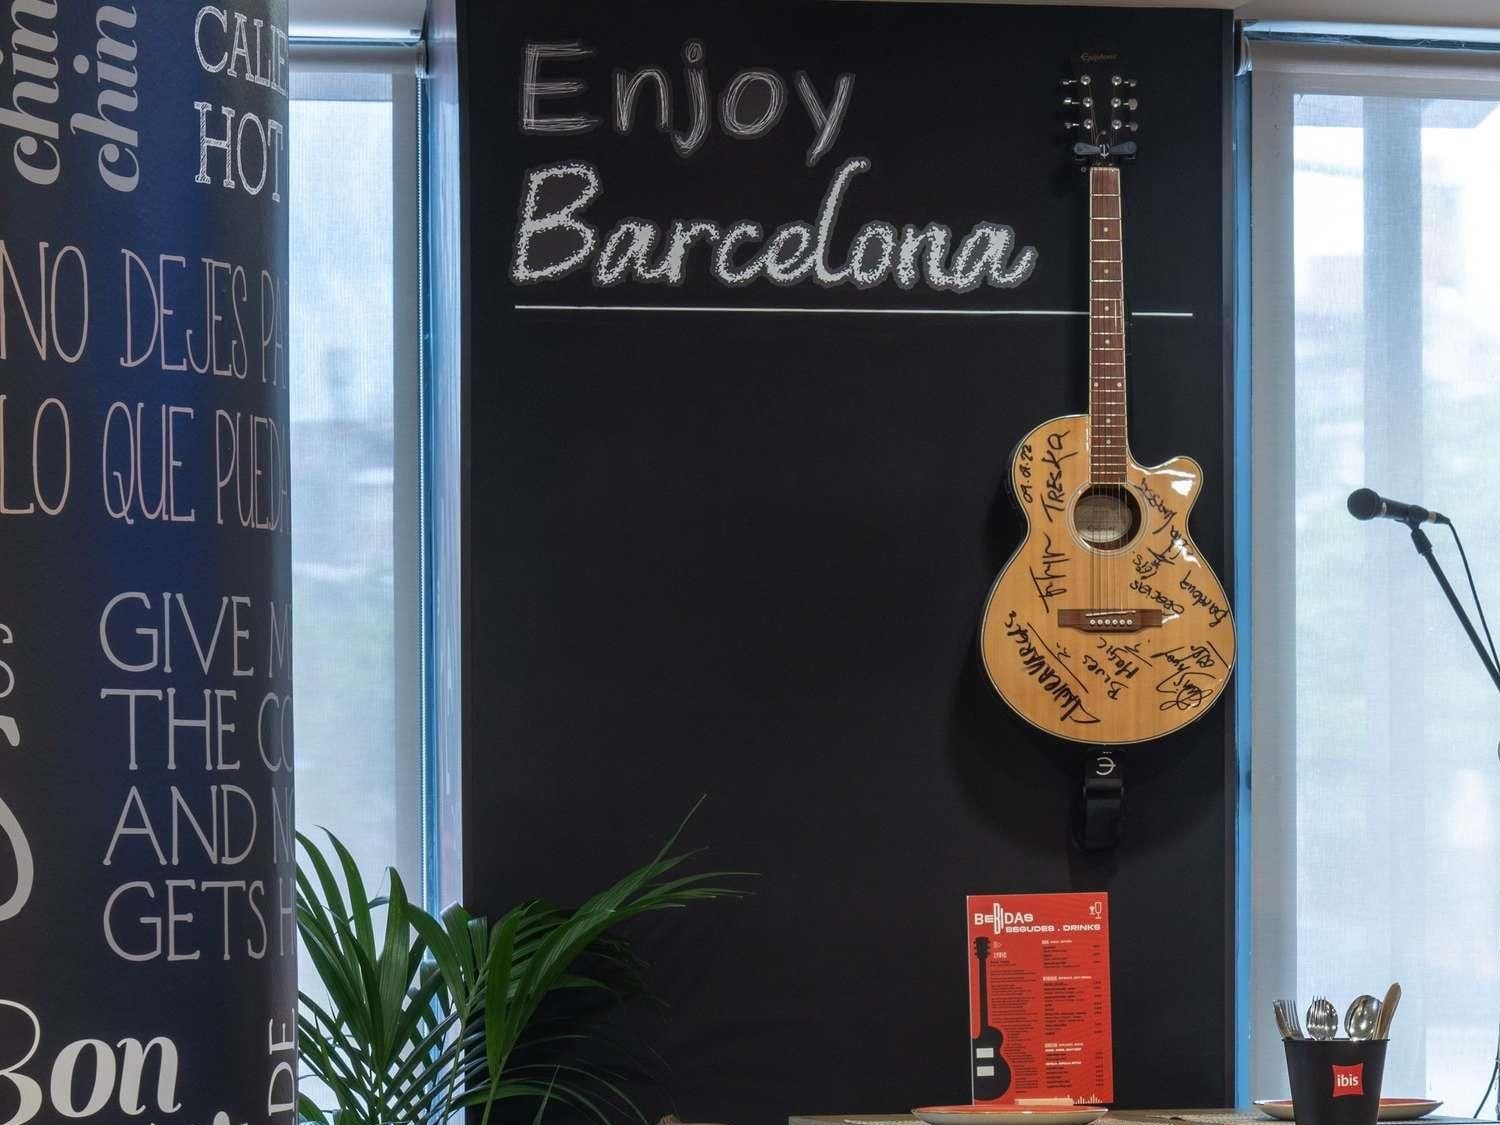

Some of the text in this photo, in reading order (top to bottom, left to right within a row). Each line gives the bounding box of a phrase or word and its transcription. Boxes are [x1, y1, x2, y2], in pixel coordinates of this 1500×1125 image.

[70, 6, 140, 192] chin
[520, 40, 856, 166] Enjoy
[194, 101, 284, 202] HOT
[511, 157, 1037, 290] Barcelona
[0, 238, 89, 364] NO
[120, 248, 248, 380] DEJES
[102, 400, 195, 525] QUE
[100, 591, 254, 677] GIVE
[100, 687, 241, 770] THE
[103, 785, 257, 867] AND
[103, 879, 267, 961] GETS
[1062, 923, 1101, 932] DRINKS
[1337, 1074, 1359, 1087] ibis
